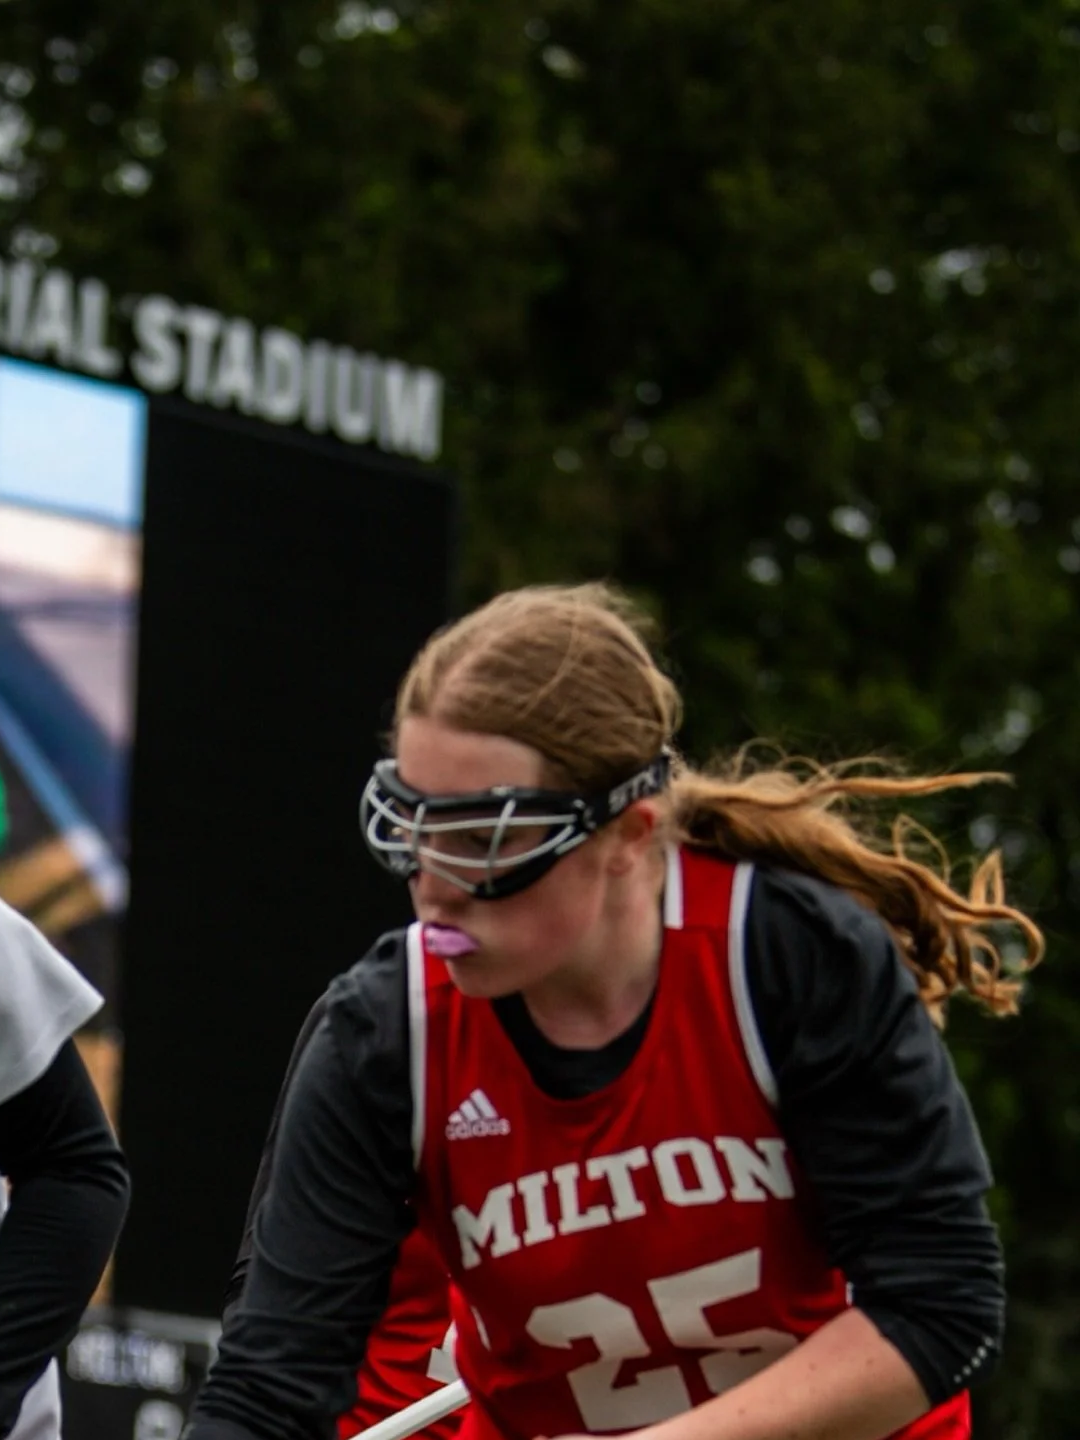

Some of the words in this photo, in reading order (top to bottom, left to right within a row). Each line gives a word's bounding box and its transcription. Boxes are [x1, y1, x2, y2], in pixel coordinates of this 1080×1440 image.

[130, 293, 444, 462] STADIUM
[445, 1118, 511, 1141] adidas
[451, 1135, 795, 1271] MILTON
[525, 1246, 799, 1432] 25
